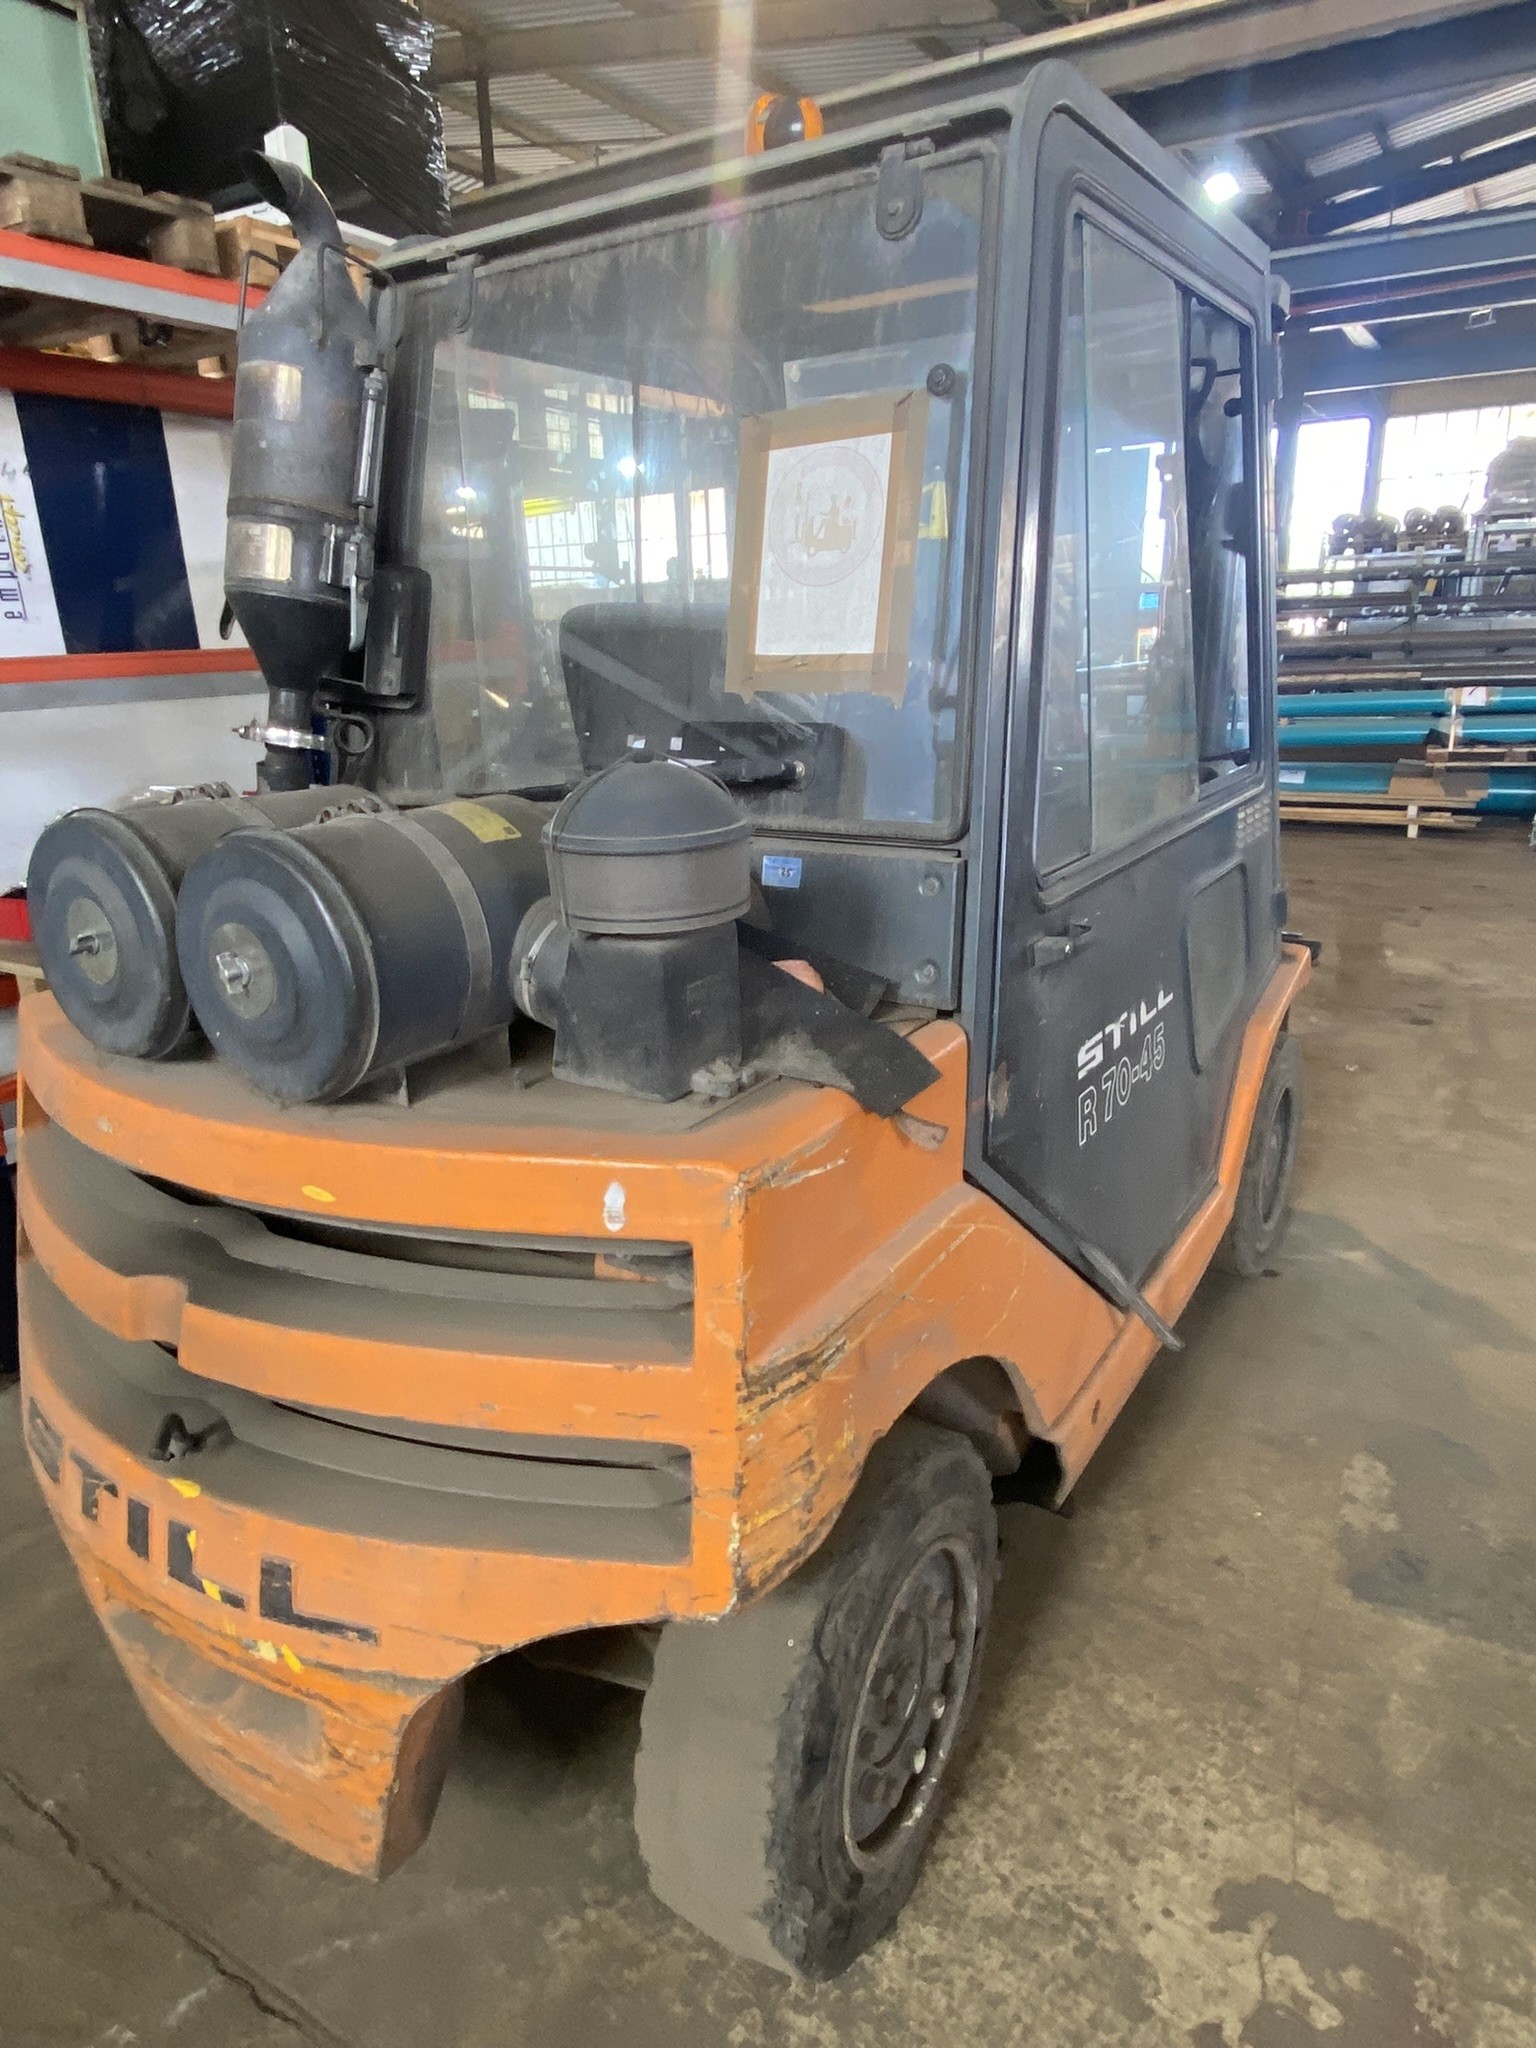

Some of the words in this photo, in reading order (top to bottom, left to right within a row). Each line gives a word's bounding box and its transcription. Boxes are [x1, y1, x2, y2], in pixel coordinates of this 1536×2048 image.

[1077, 989, 1174, 1081] STILL
[1078, 1085, 1098, 1146] R
[1101, 1021, 1166, 1123] 70-45
